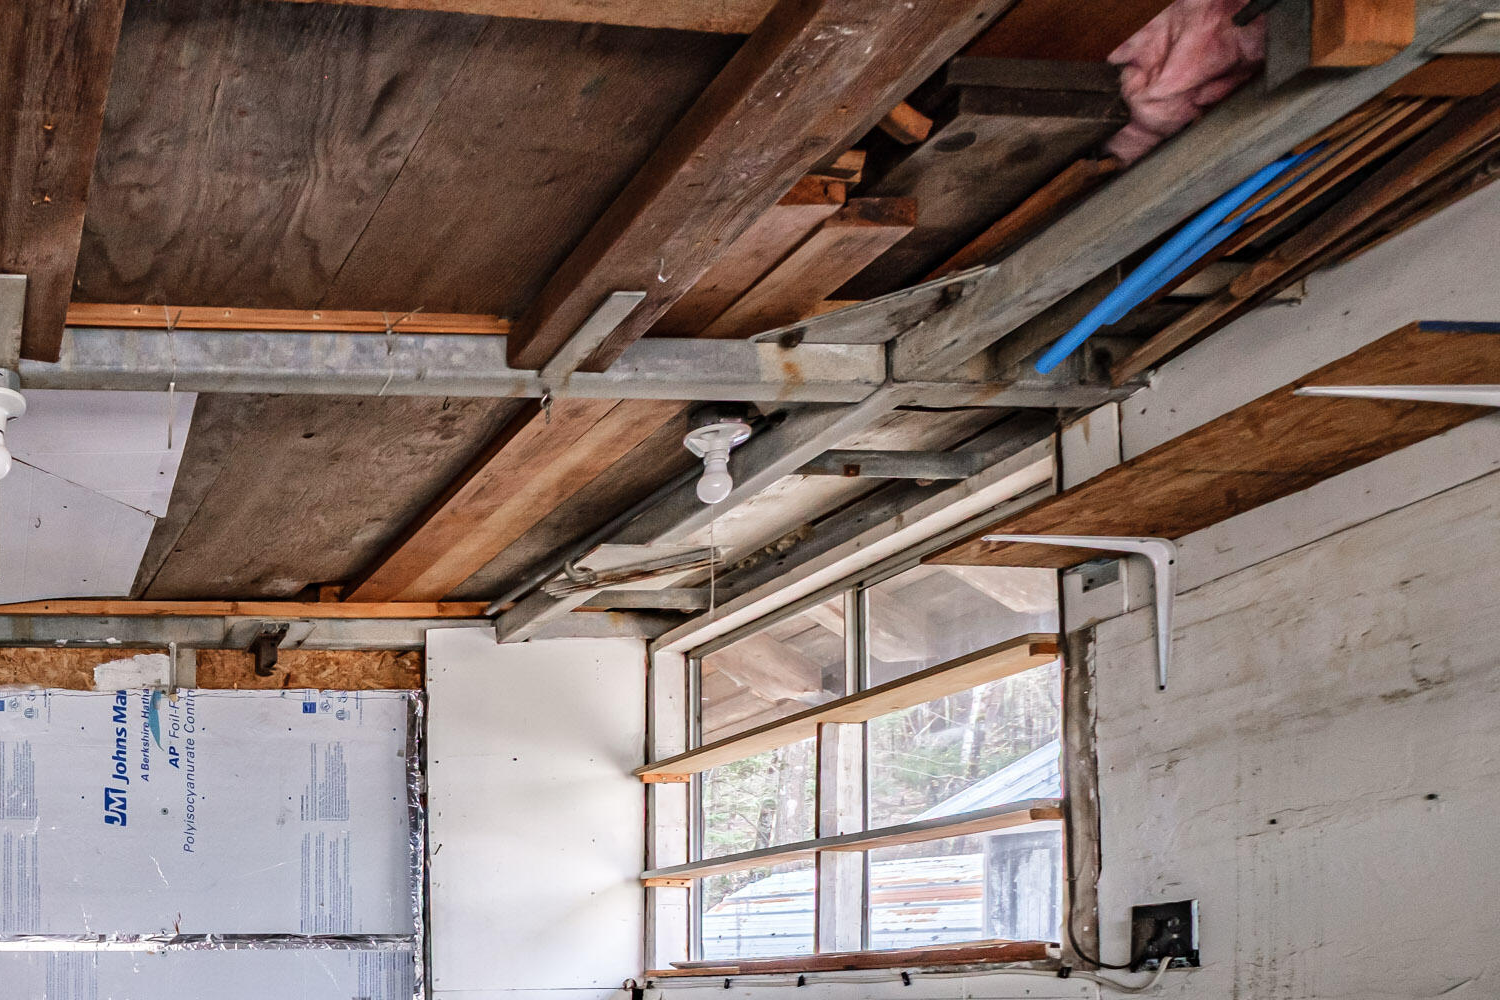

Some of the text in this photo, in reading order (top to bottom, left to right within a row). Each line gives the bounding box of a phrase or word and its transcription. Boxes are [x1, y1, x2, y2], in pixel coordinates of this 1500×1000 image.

[111, 727, 129, 785] Johns
[141, 722, 150, 771] Berkshire
[169, 746, 180, 769] AP
[141, 774, 150, 782] A
[183, 738, 197, 853] Polyisocyanurate
